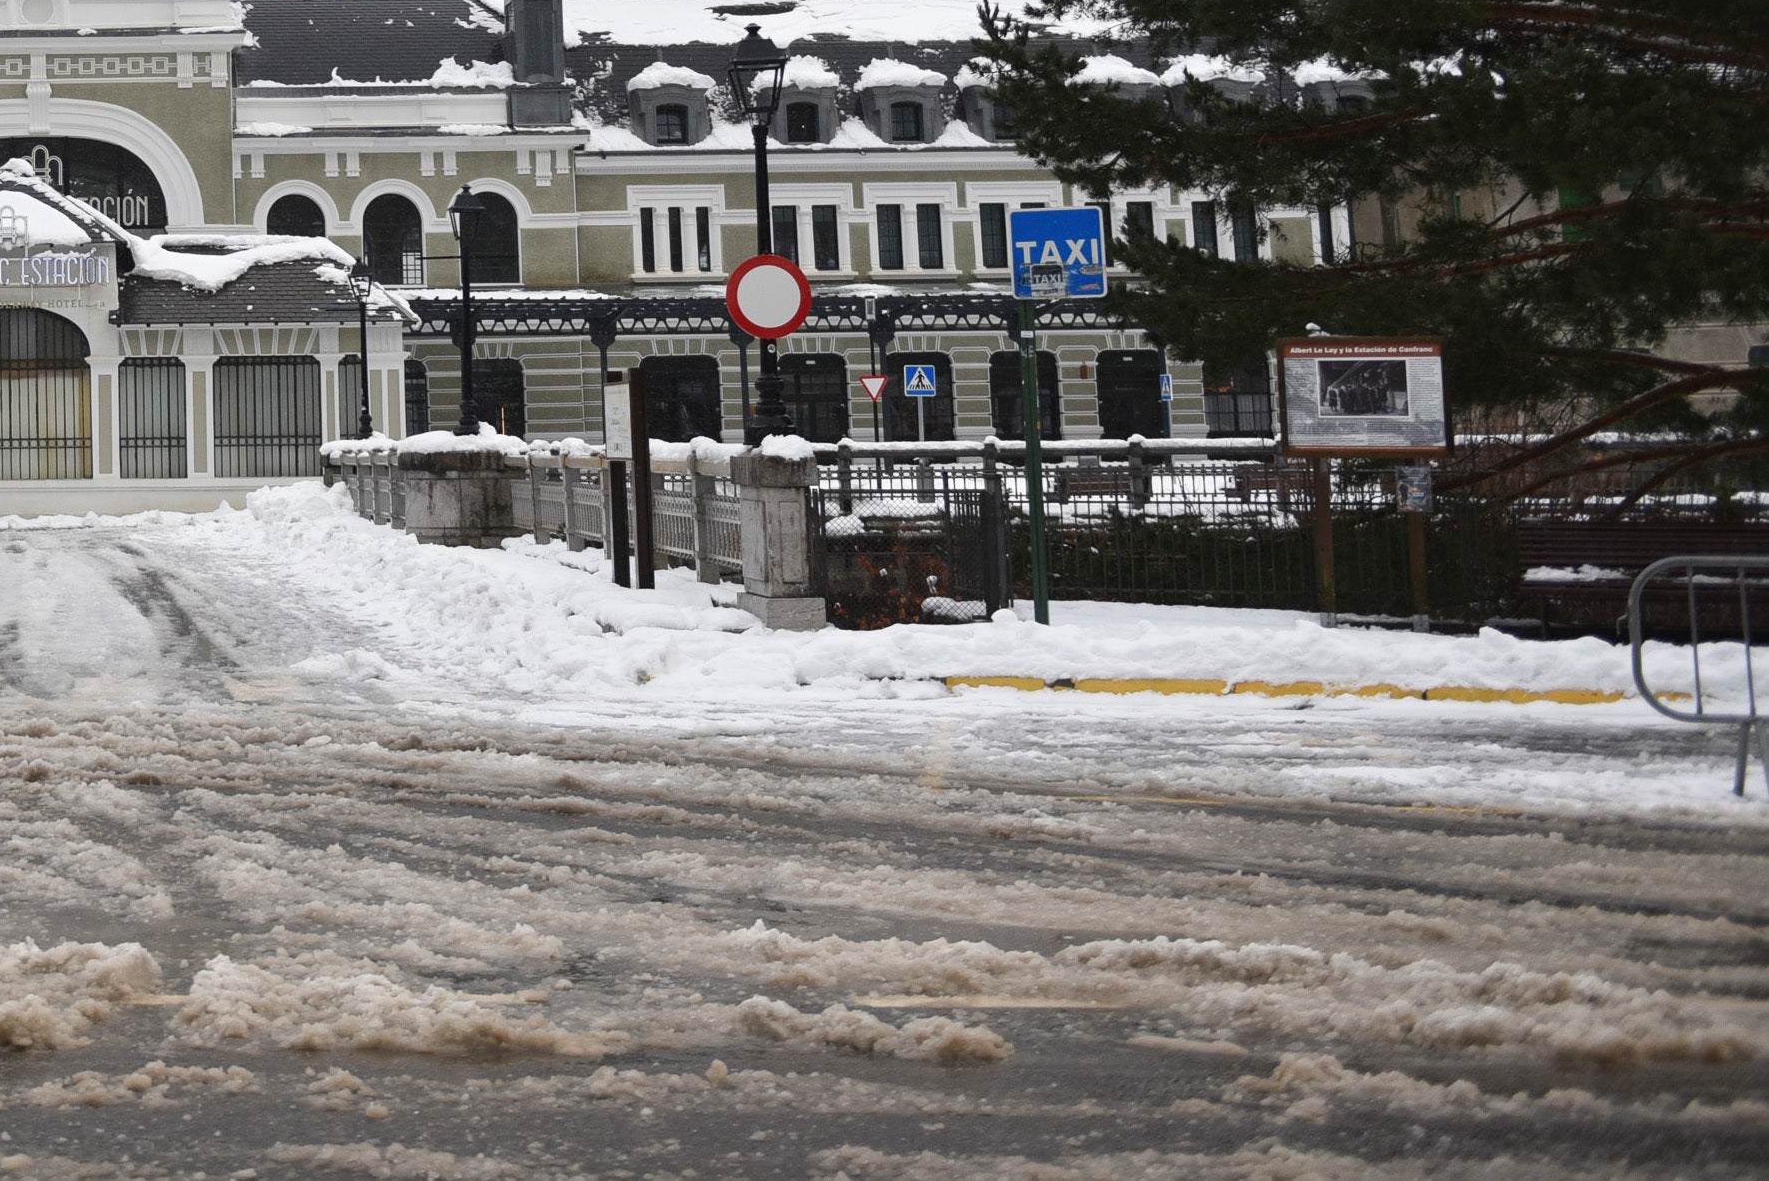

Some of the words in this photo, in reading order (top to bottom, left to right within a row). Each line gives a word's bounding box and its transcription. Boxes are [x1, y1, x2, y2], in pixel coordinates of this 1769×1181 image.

[1015, 238, 1099, 265] TAXI
[21, 247, 110, 285] ESTACIÓN
[1034, 274, 1061, 284] TAXI
[48, 299, 83, 308] HOTEL
[1324, 347, 1338, 355] Lay
[1354, 345, 1386, 353] Estación
